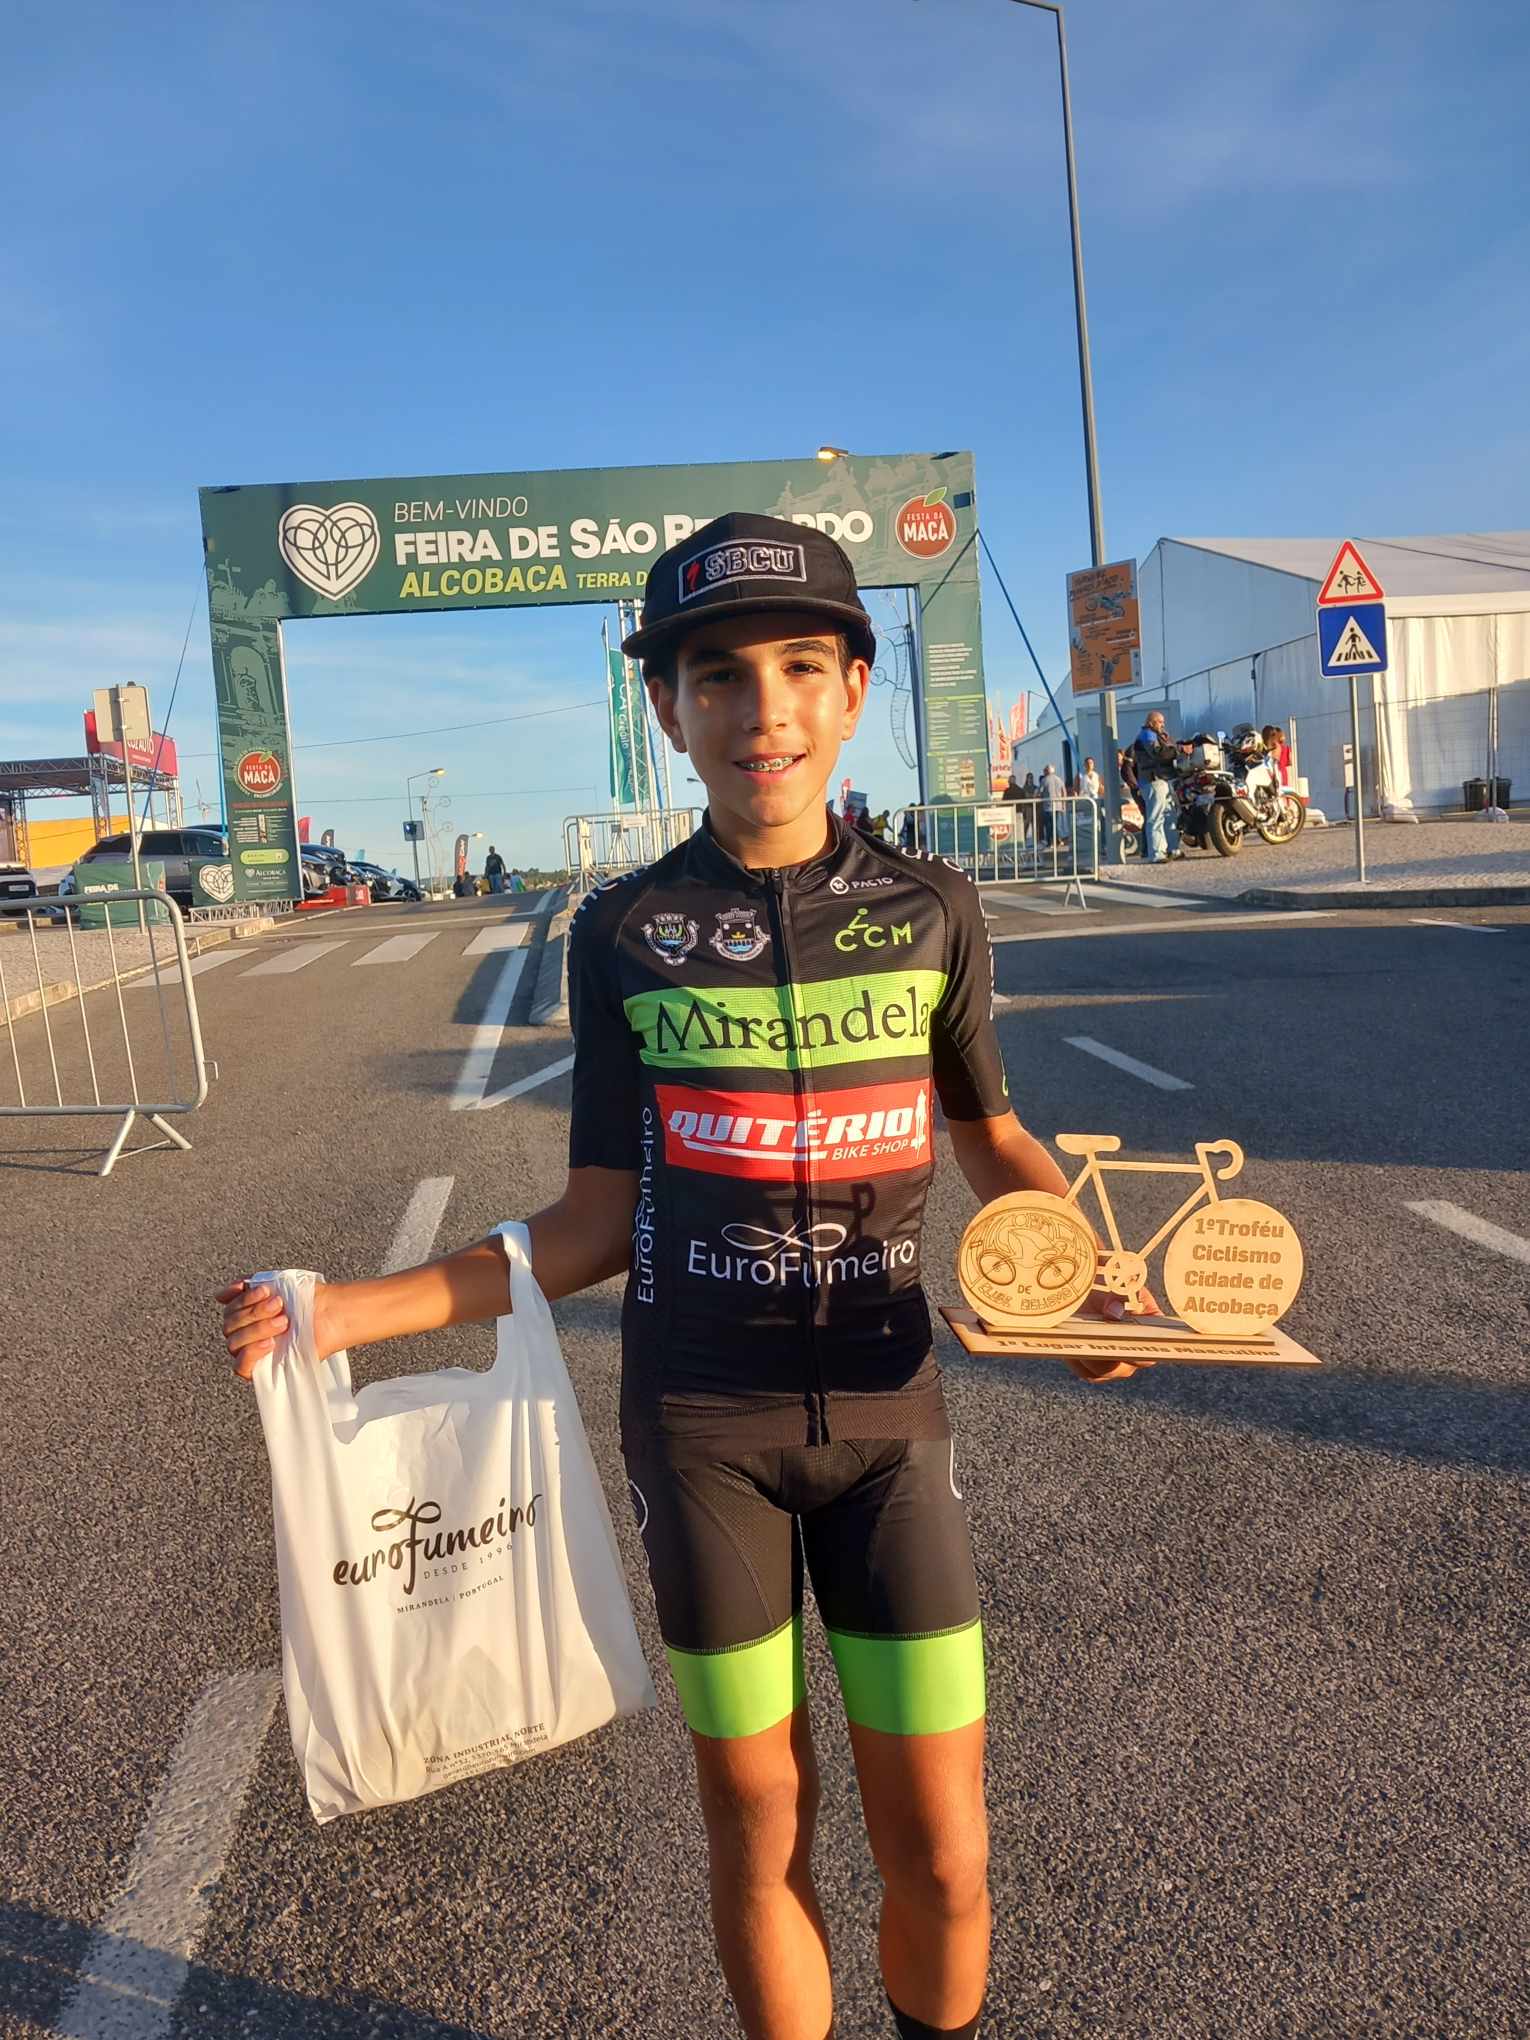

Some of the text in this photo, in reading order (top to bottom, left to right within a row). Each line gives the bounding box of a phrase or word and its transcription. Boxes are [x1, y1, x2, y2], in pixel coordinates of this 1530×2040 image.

[394, 496, 529, 524] BEM-VINDO
[395, 528, 503, 566] FEIRA
[508, 525, 560, 561] DE
[570, 517, 658, 560] SÃO
[704, 546, 794, 582] SBCU
[400, 564, 568, 599] ALCOBAÇA
[575, 571, 632, 589] TERRA
[851, 876, 894, 889] PACTO
[834, 920, 913, 952] CCM
[655, 986, 930, 1054] Mirandela
[667, 1106, 915, 1148] QUITÉRIO
[831, 1138, 909, 1161] BIKE SHOP
[1192, 1243, 1282, 1265] Ciclismo
[1184, 1270, 1284, 1291] Cidade de
[1183, 1296, 1280, 1319] Alcobaça
[1016, 1341, 1085, 1352] Lugar
[1175, 1347, 1281, 1357] Masculino
[423, 1561, 469, 1580] DESDE
[396, 1596, 450, 1614] MIRANDELA
[459, 1575, 504, 1600] PORTUGAL
[423, 1722, 545, 1764] ZONA INDUSTRIAL NORTE
